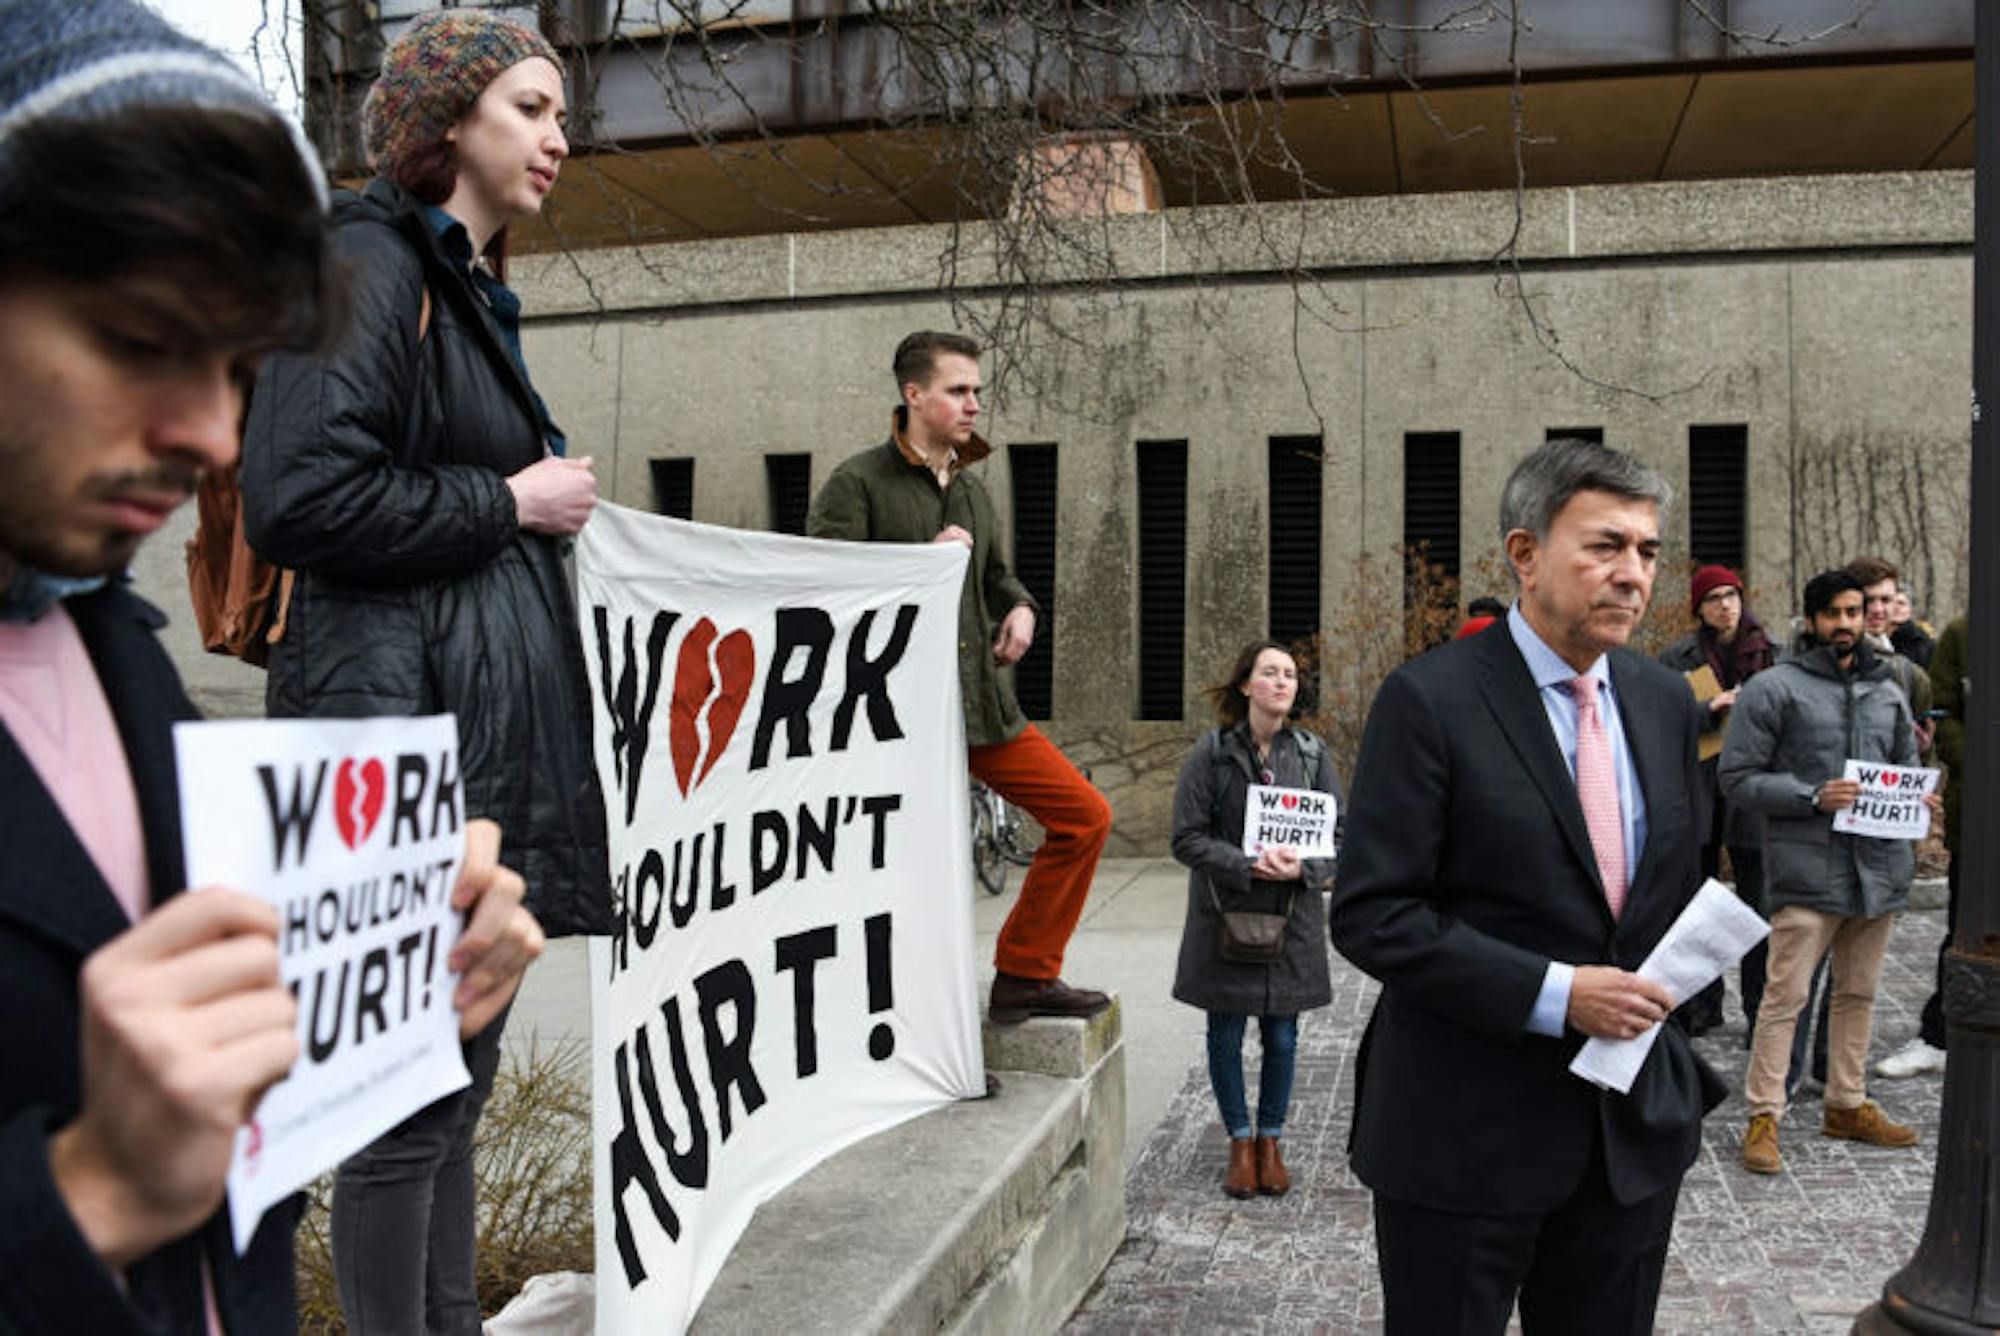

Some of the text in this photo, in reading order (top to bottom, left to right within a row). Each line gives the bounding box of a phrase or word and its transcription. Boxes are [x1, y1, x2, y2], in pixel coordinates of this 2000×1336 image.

[1258, 825, 1323, 848] HURT!
[1852, 800, 1920, 823] HURT!
[284, 857, 454, 955] HOULDN'T
[609, 794, 903, 983] HOULDN'T
[288, 925, 438, 1064] URT!
[610, 911, 896, 1290] HURT!
